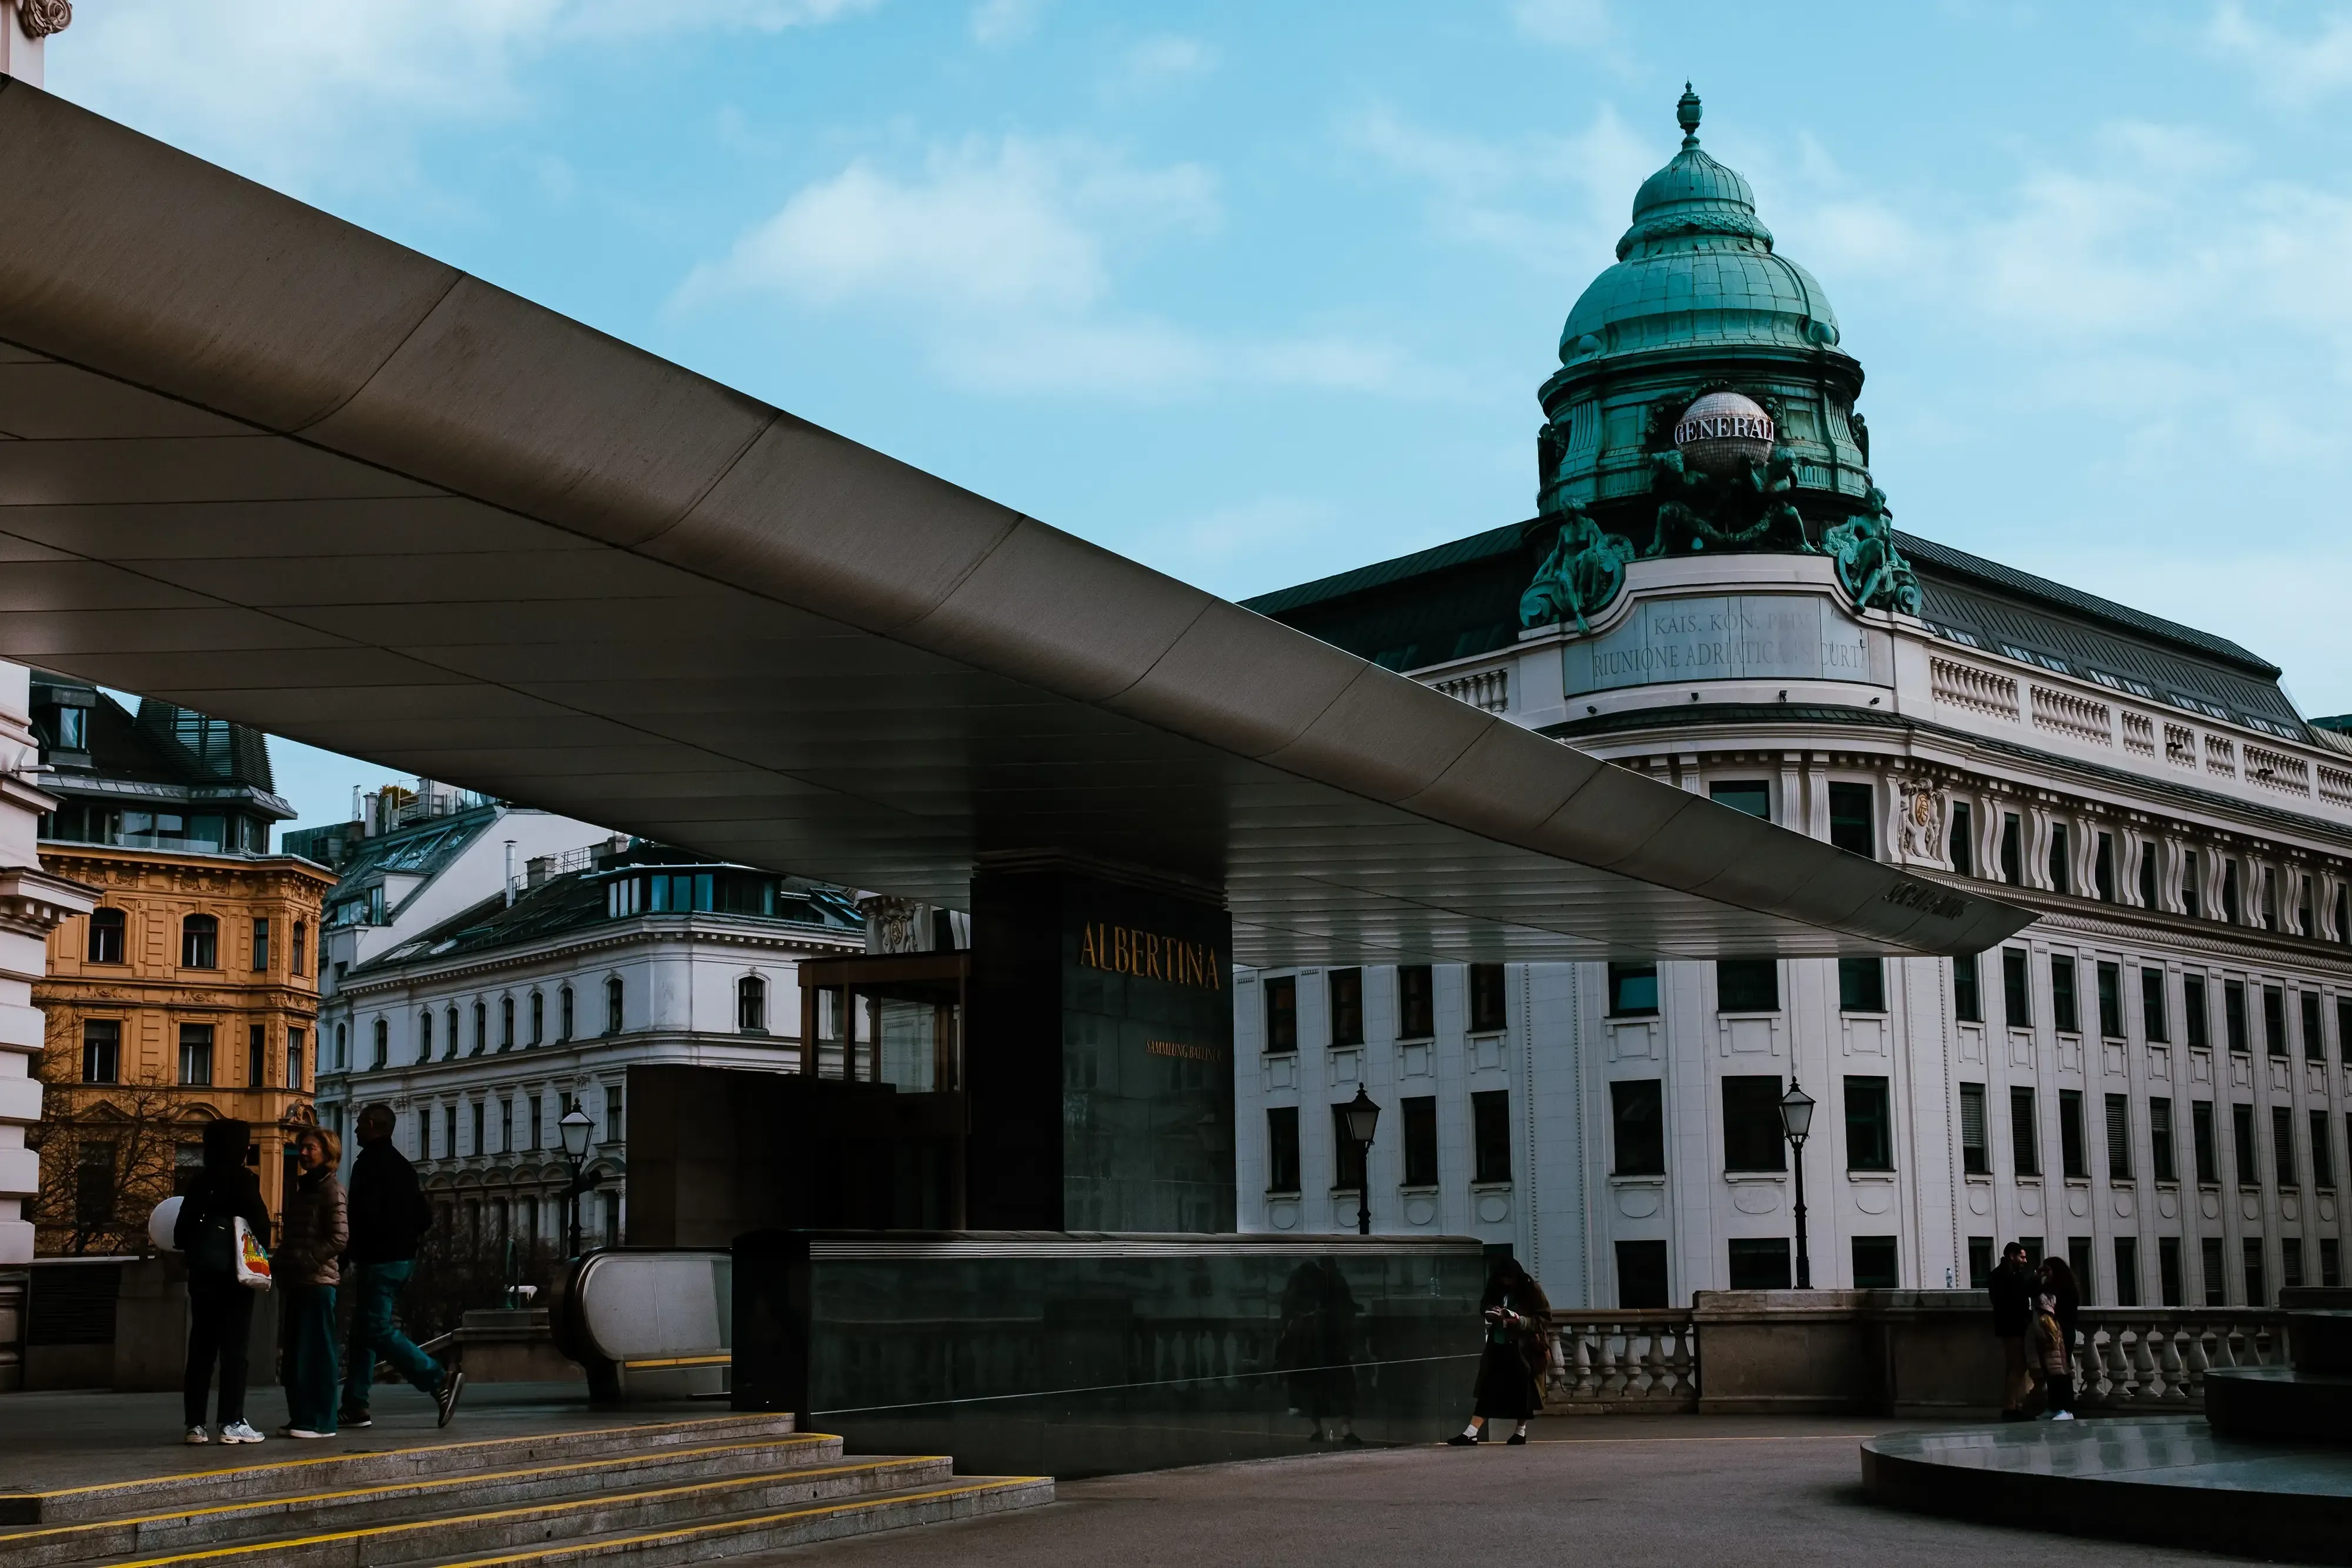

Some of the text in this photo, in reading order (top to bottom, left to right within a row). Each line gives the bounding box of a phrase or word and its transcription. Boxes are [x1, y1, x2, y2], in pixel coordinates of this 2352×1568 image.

[1675, 417, 1775, 445] GENERALI
[1655, 614, 1702, 635] KAIS.
[1593, 644, 1680, 677] RIUNIONE
[1080, 920, 1220, 991] ALBERTINA
[1146, 1039, 1188, 1058] SAMMLUNG
